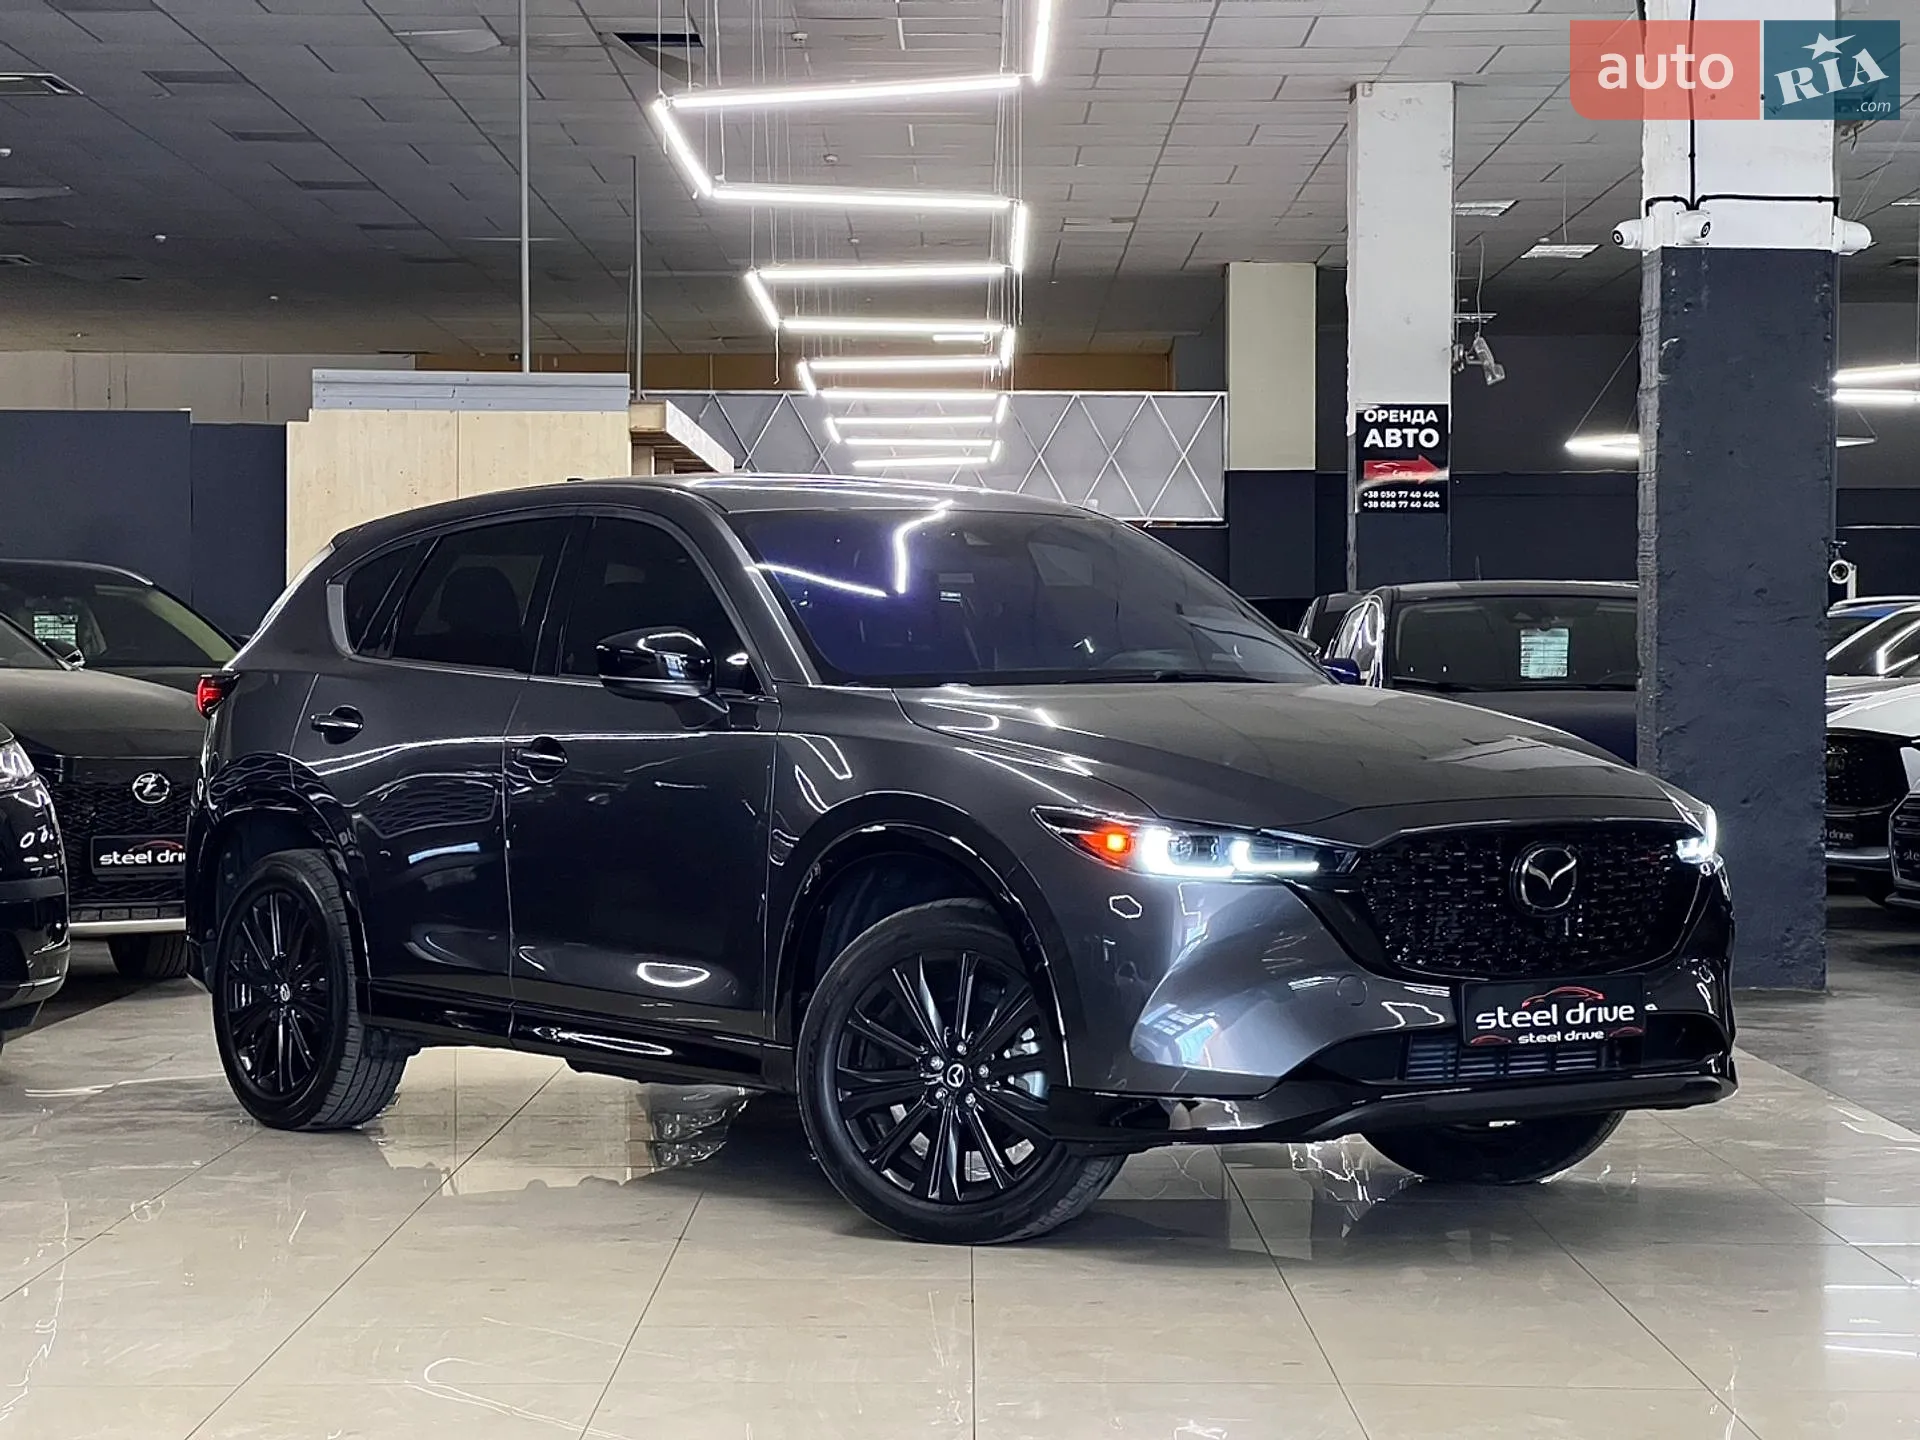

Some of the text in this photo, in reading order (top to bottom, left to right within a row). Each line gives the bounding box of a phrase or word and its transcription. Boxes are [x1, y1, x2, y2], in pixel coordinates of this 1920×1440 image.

[1363, 409, 1439, 425] ОРЕНДА
[1363, 427, 1440, 448] АВТО
[99, 849, 152, 866] steel
[1475, 1001, 1636, 1030] steel drive
[1517, 1030, 1604, 1044] steel drive
